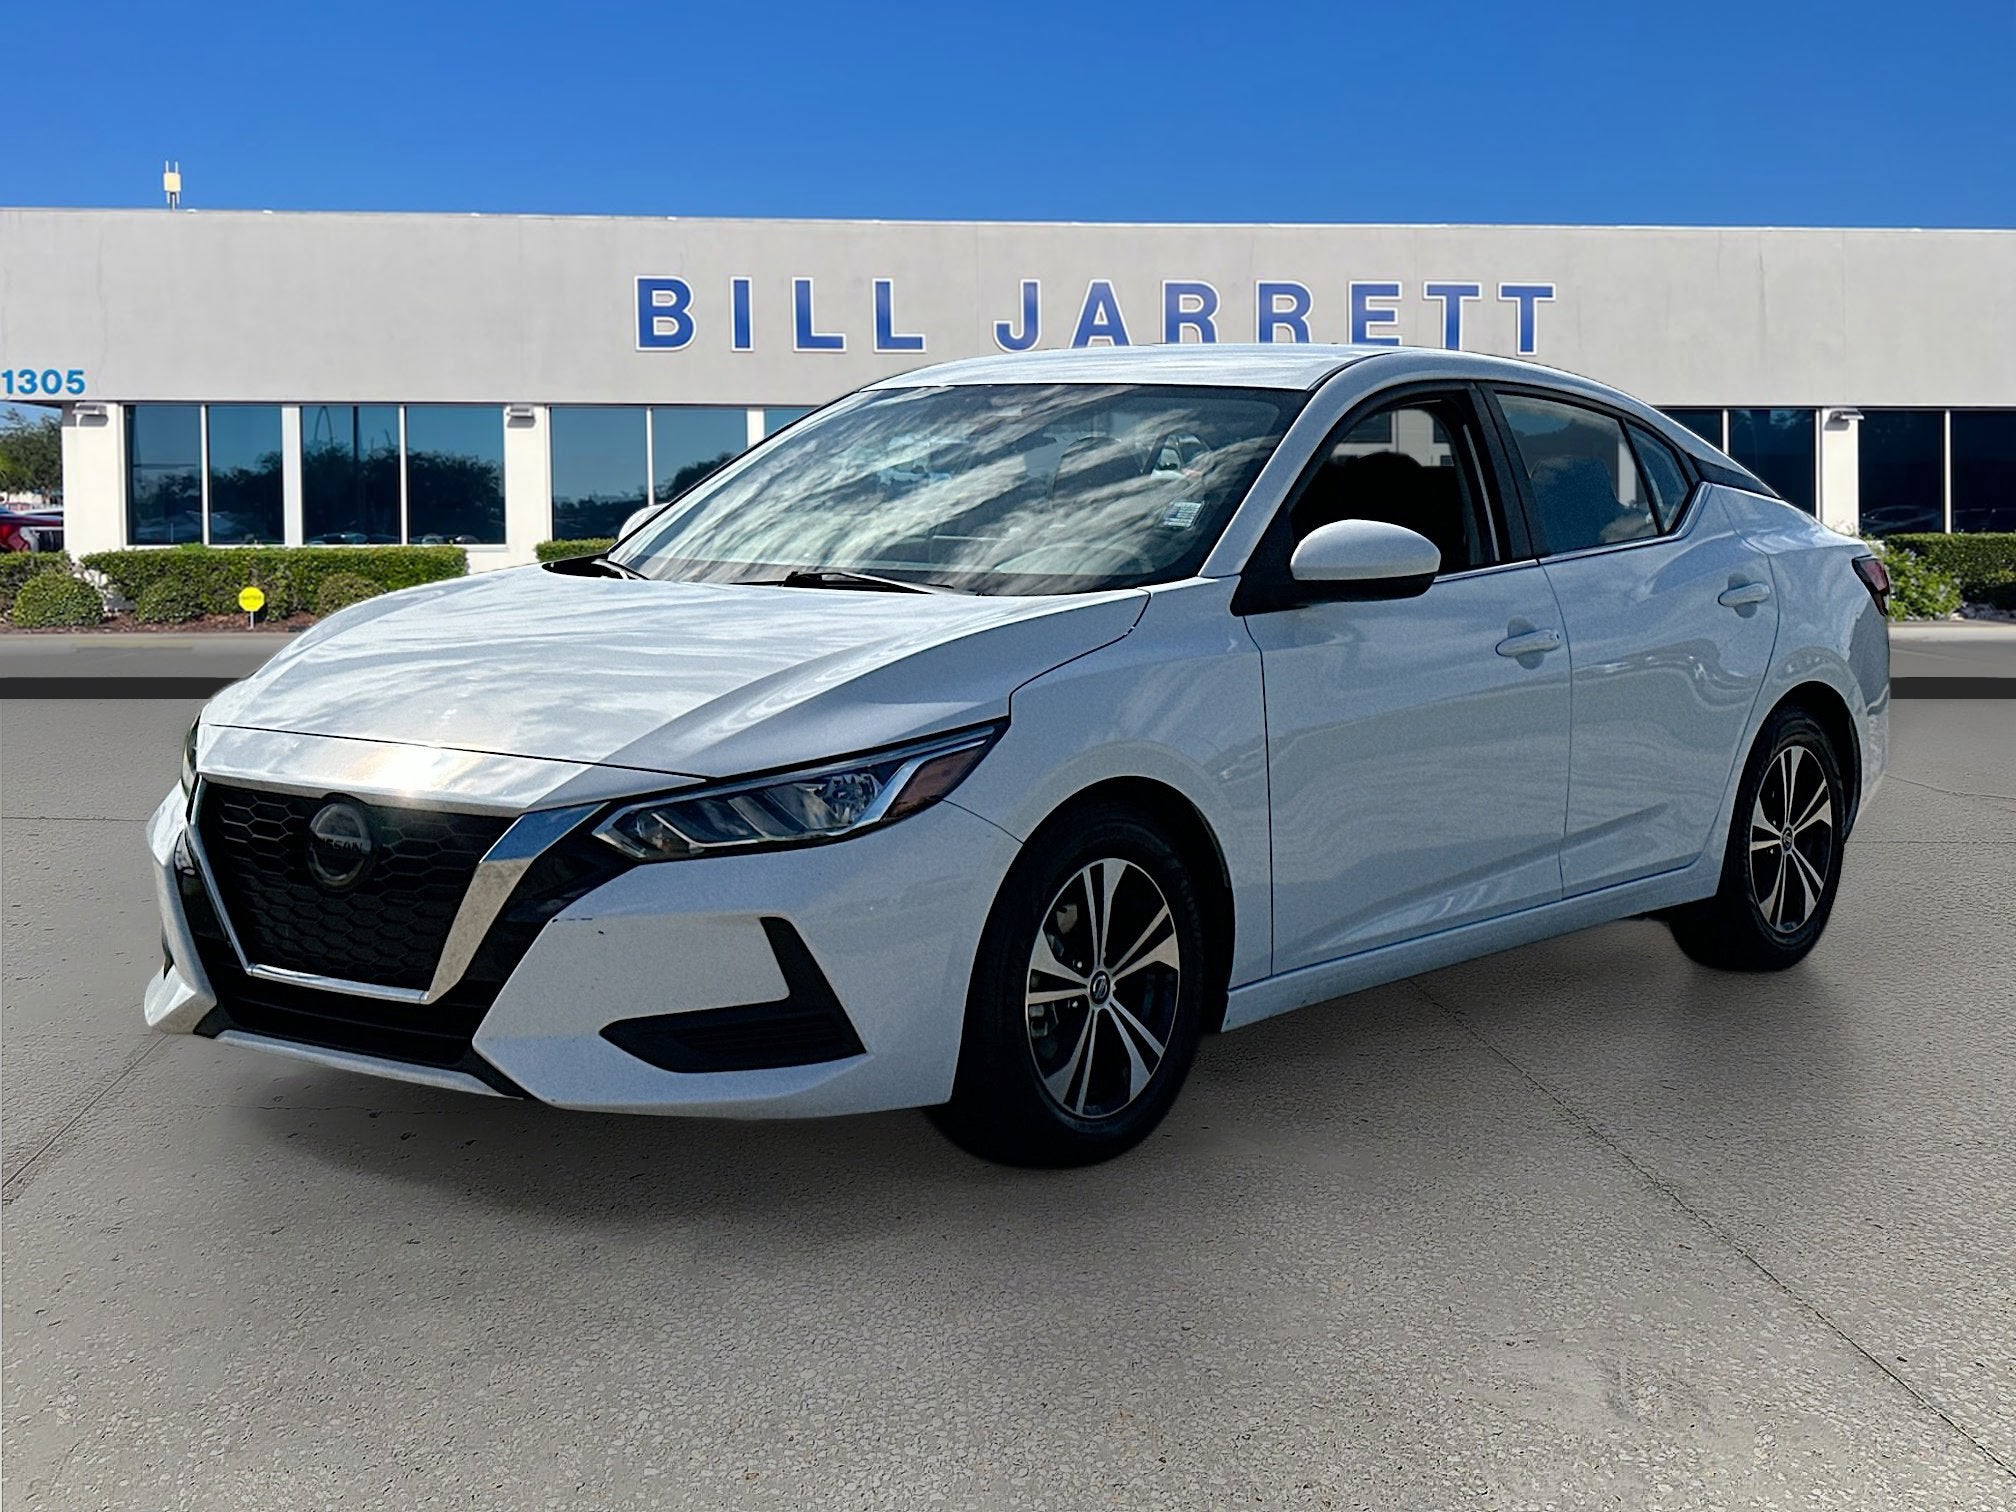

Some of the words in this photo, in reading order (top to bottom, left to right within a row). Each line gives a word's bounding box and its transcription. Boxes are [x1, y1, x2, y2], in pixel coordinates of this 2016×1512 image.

[635, 275, 925, 354] BILL
[995, 280, 1556, 356] JARRETT
[1, 368, 86, 395] 1305
